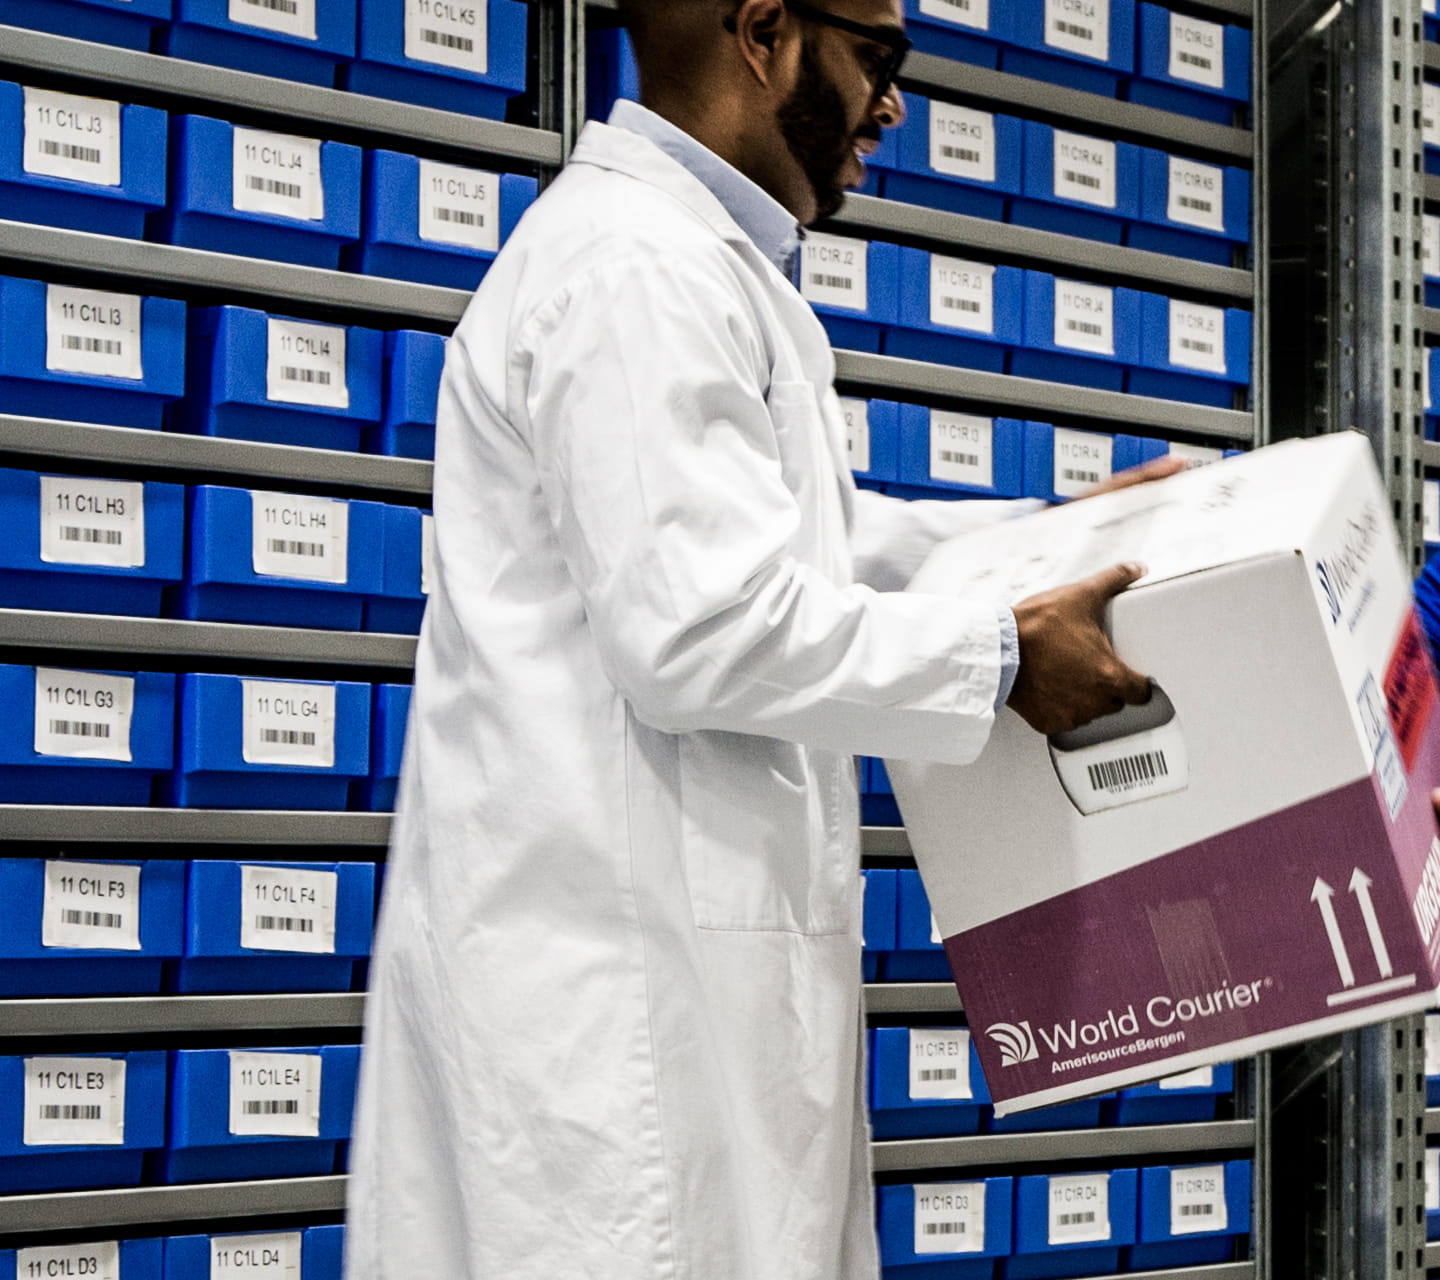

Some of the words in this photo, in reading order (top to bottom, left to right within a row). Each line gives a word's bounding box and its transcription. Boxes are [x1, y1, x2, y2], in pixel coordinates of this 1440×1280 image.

[62, 302, 75, 319] 11
[79, 304, 106, 325] C1L
[109, 308, 121, 327] I3
[1038, 1004, 1140, 1055] World
[1051, 1029, 1186, 1074] AmerisourceBergen
[38, 1071, 51, 1087] 11
[56, 1071, 83, 1091] C1L
[86, 1071, 104, 1091] E3
